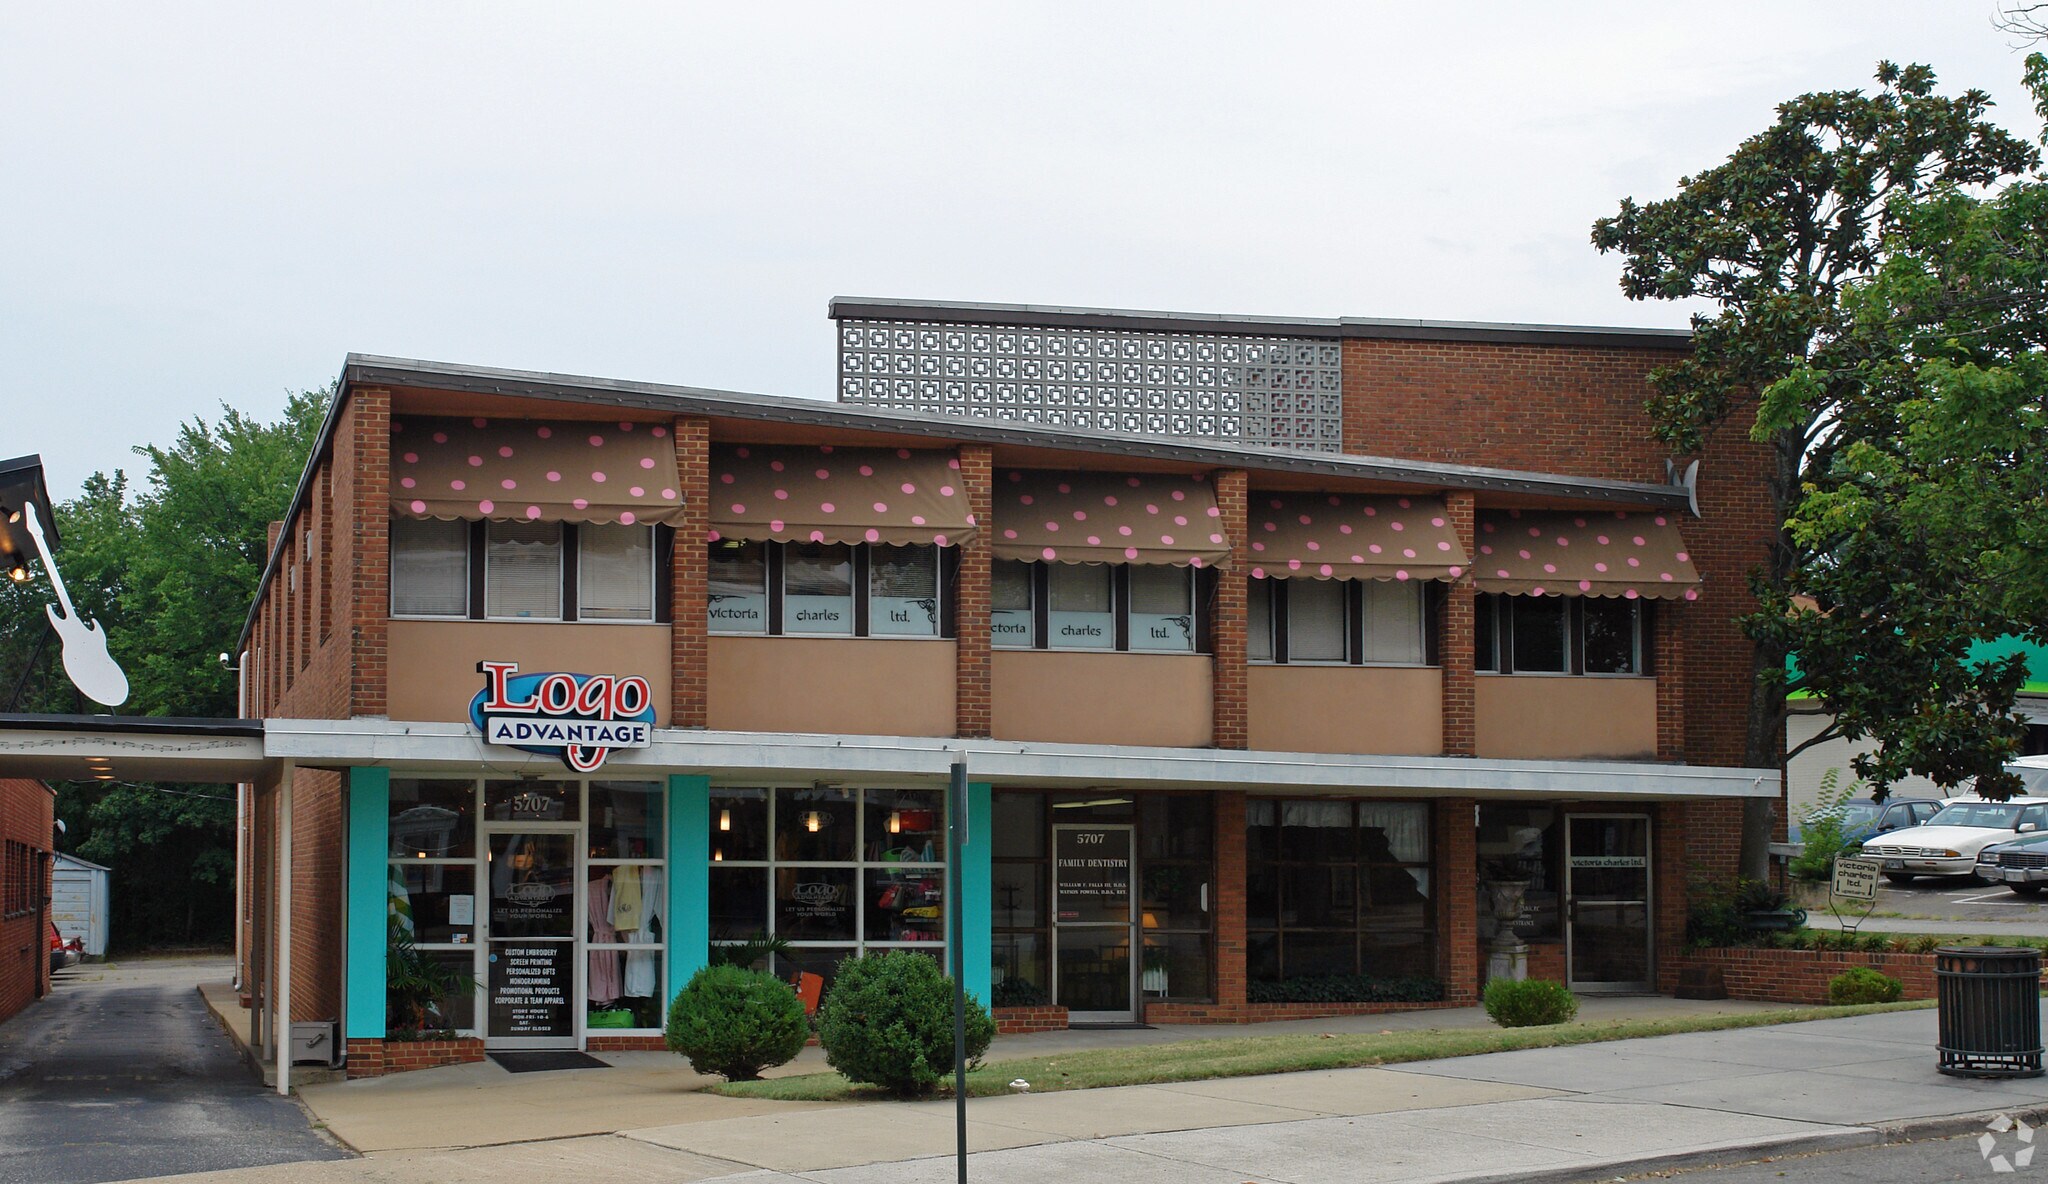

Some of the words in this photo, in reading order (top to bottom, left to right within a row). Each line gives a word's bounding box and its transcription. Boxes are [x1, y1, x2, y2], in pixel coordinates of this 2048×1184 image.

[709, 607, 759, 620] victoria
[796, 609, 840, 622] charles
[890, 610, 911, 623] ltd.
[991, 622, 1027, 634] ctoria
[1061, 624, 1102, 637] charles
[1150, 626, 1170, 639] ltd.
[481, 660, 652, 773] Logo
[496, 722, 645, 743] ADVANTAGE
[513, 795, 550, 812] 5707
[1077, 833, 1105, 844] 5707
[1058, 859, 1086, 868] FAMILY
[1087, 859, 1128, 868] DENTISTRY
[1571, 858, 1602, 866] victoria
[1604, 858, 1630, 866] charles
[1630, 858, 1644, 866] ltd.
[1838, 861, 1876, 872] victoria
[1838, 870, 1873, 880] charles
[1847, 879, 1862, 887] ltd.
[505, 948, 525, 956] CUSTOM
[526, 948, 558, 956] EMBROIDERY
[510, 958, 529, 966] SCREEN
[530, 958, 553, 966] PRINTING
[509, 977, 551, 985] MONOGRAMMING
[500, 987, 534, 995] PROMOTIONAL
[535, 987, 560, 995] PRODUCTS
[494, 997, 523, 1005] CORPORATE
[530, 997, 543, 1005] TEAM
[543, 997, 565, 1005] APPAREL
